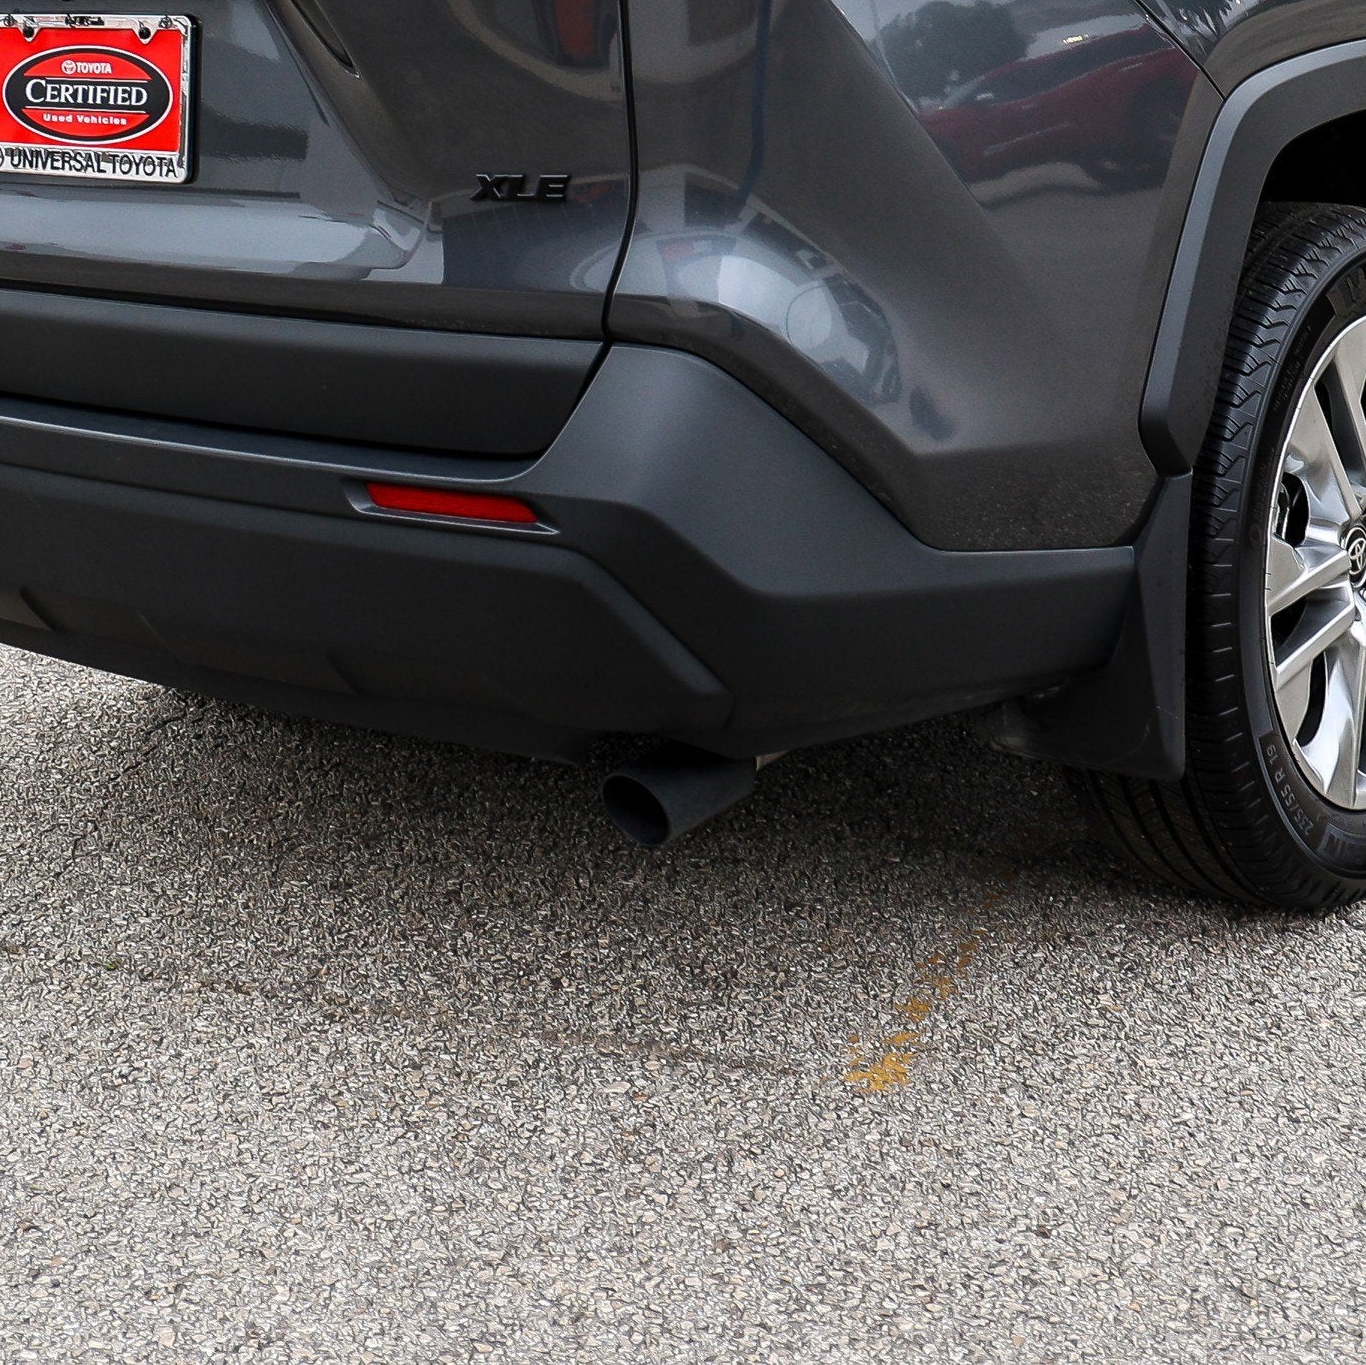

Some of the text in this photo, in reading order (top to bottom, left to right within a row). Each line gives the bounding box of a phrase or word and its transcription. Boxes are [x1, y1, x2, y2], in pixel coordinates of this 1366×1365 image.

[76, 61, 113, 74] TOYOTA
[25, 79, 148, 106] CERTIFIED
[42, 113, 128, 125] Used Vehicles
[10, 147, 179, 178] UNIVERSAL TOYOTA
[470, 173, 571, 202] XLE
[1266, 744, 1315, 836] 235/55 R 19
